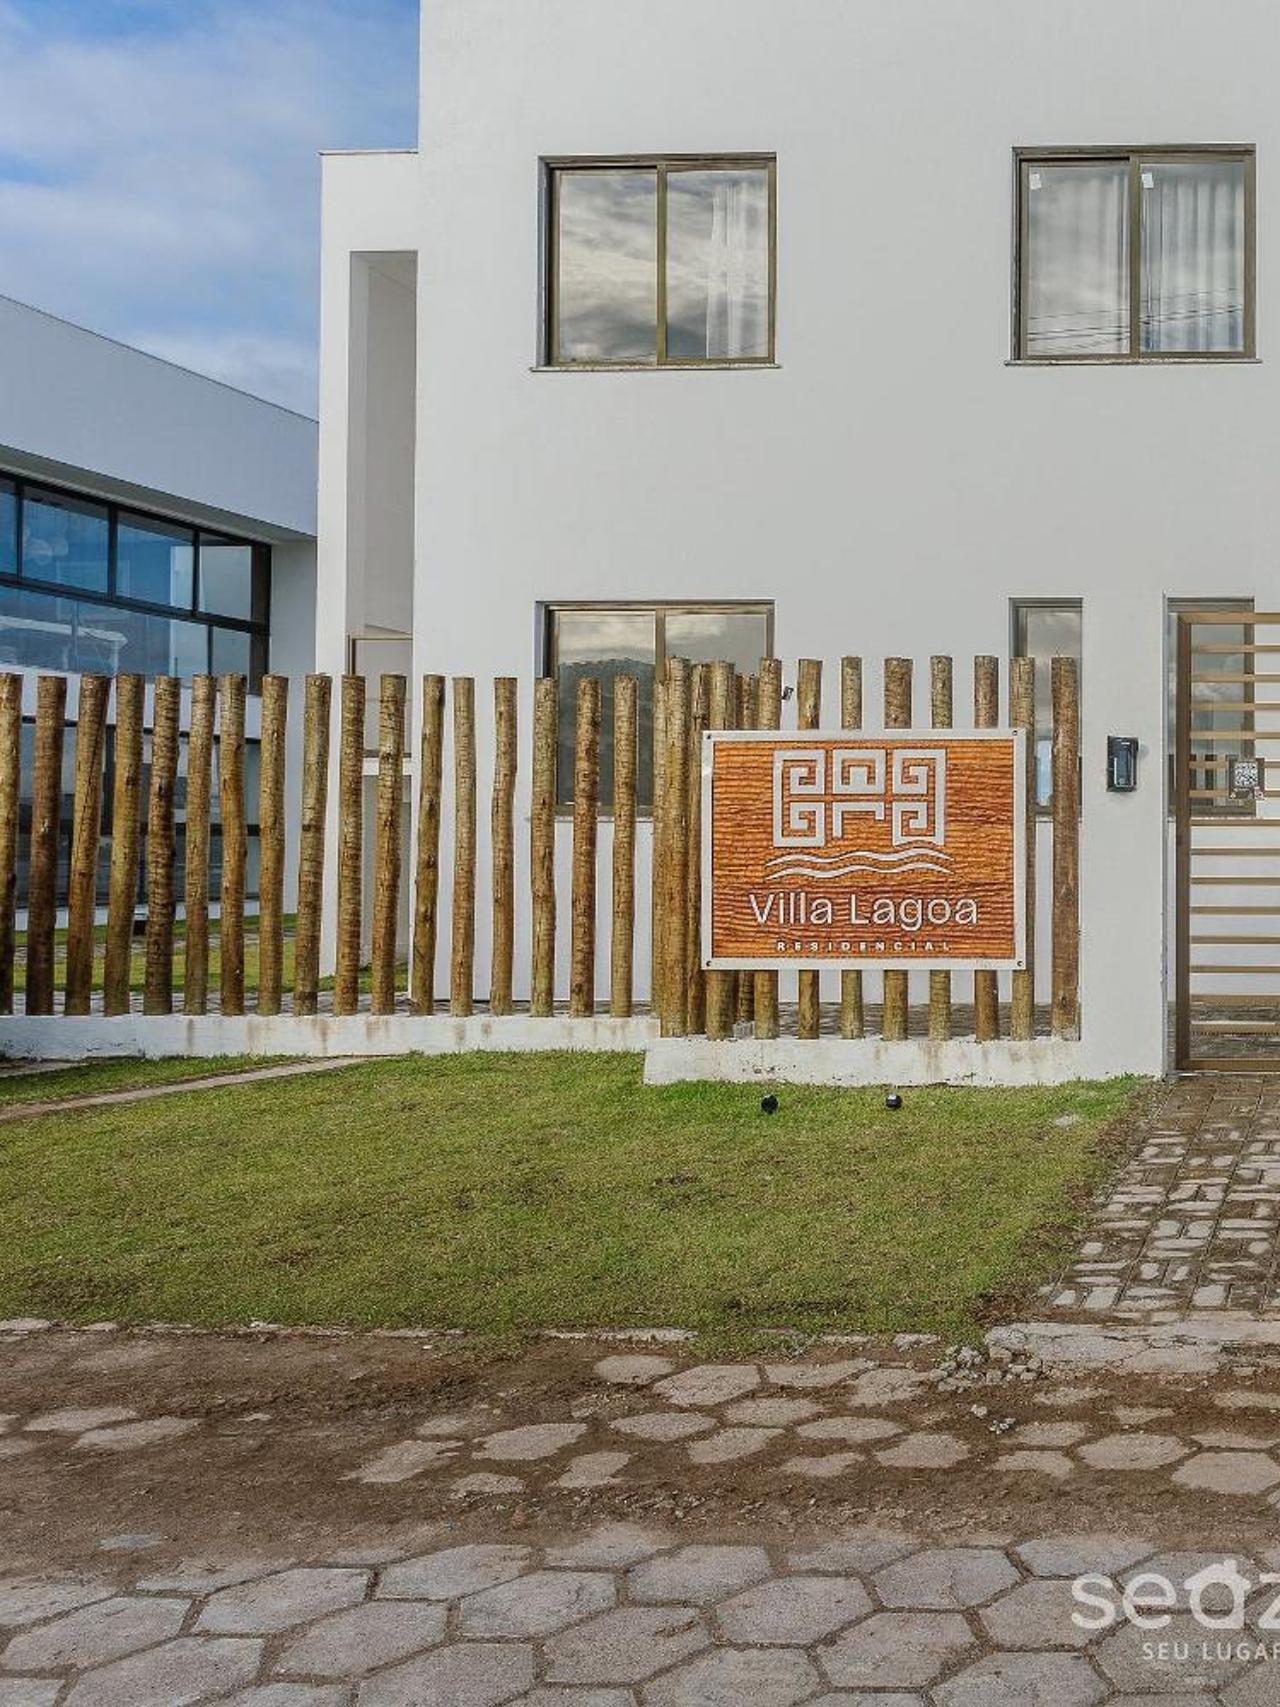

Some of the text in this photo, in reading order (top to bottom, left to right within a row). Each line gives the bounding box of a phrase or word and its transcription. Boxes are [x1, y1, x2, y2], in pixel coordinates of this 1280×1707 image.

[749, 892, 979, 931] Villa Lagoa
[776, 940, 953, 952] RESIDENCIAL
